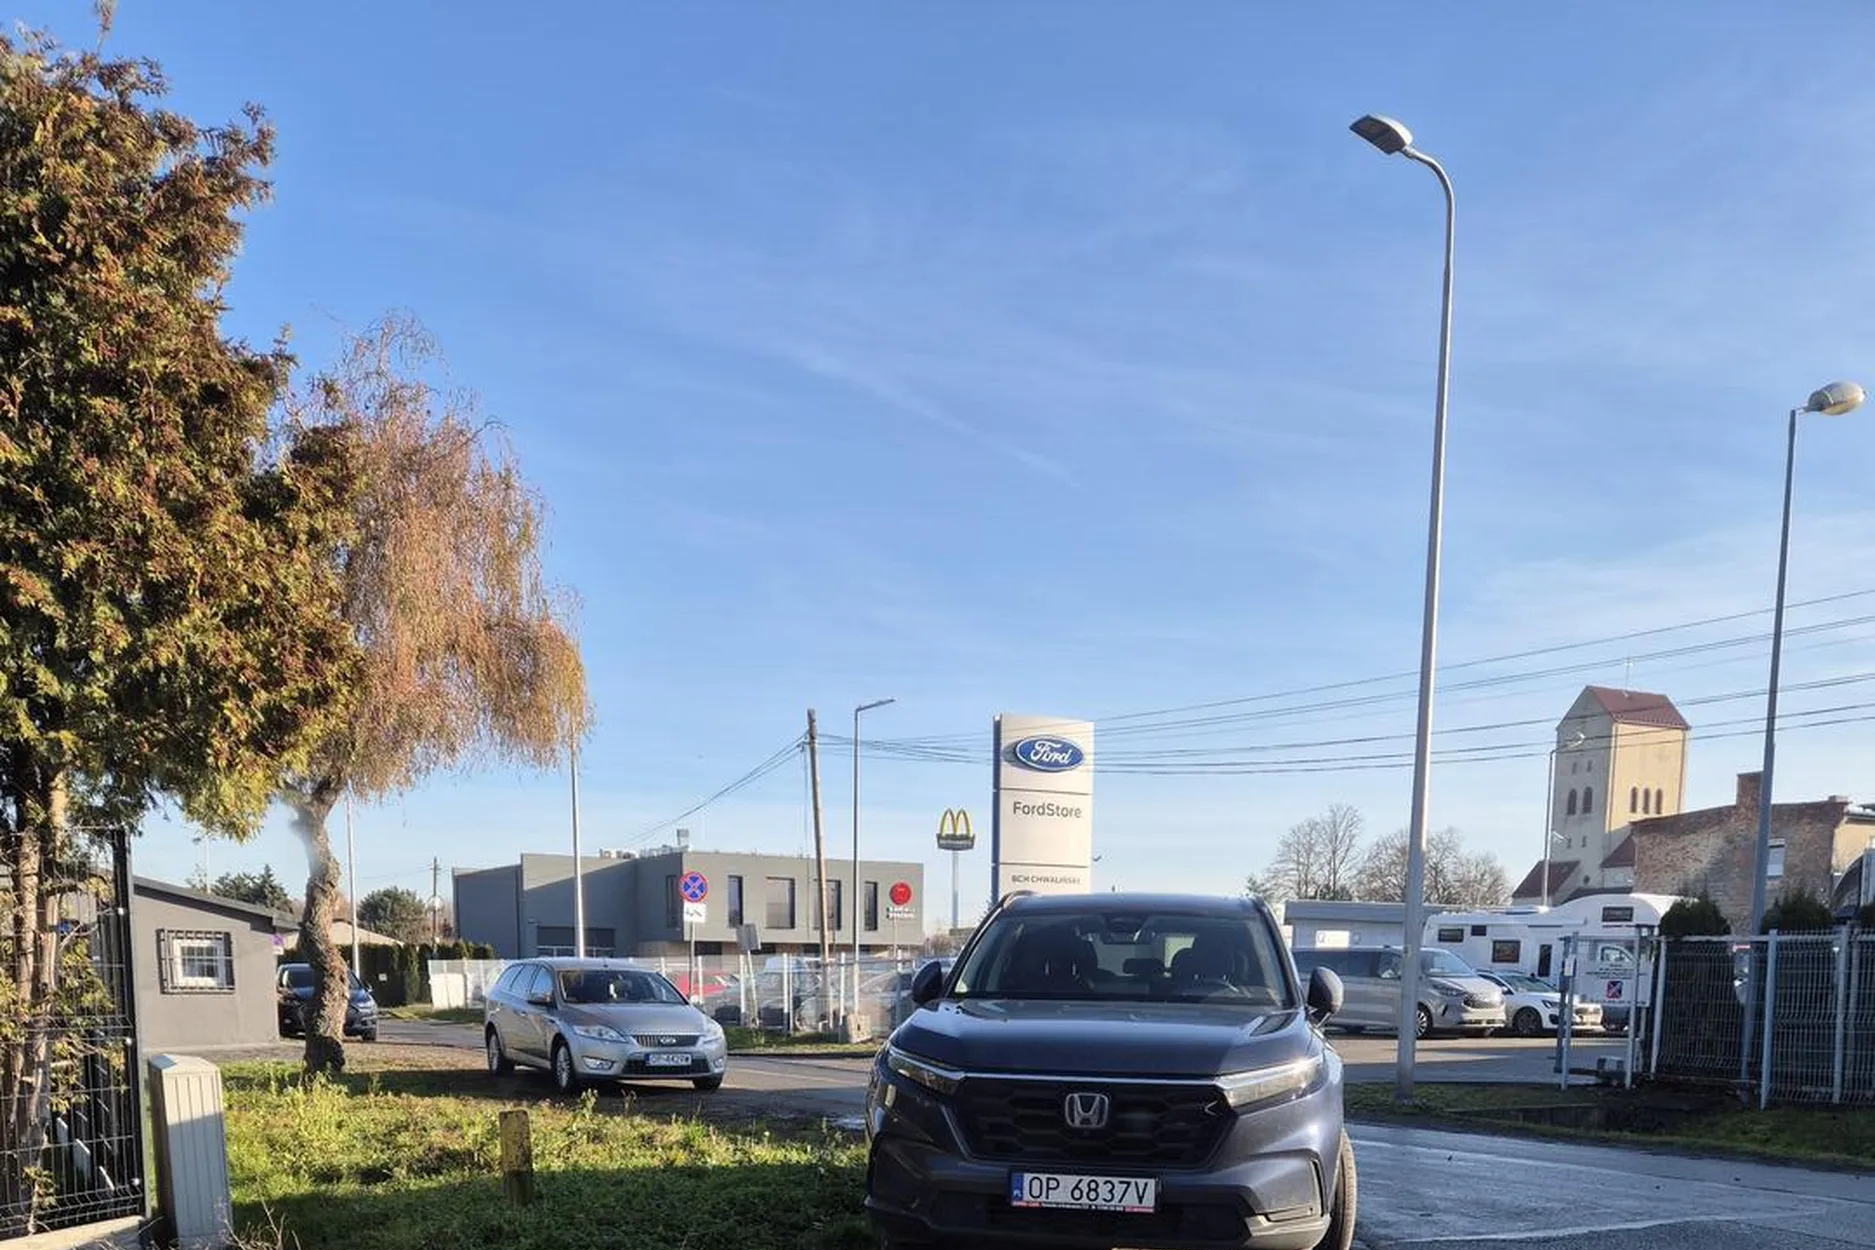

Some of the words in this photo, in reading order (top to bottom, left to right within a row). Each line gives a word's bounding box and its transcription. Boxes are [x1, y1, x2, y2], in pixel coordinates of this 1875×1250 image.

[1030, 740, 1073, 764] Ford
[1013, 801, 1082, 819] FordStore
[1028, 1176, 1060, 1200] OP
[1070, 1178, 1148, 1204] 6837V
